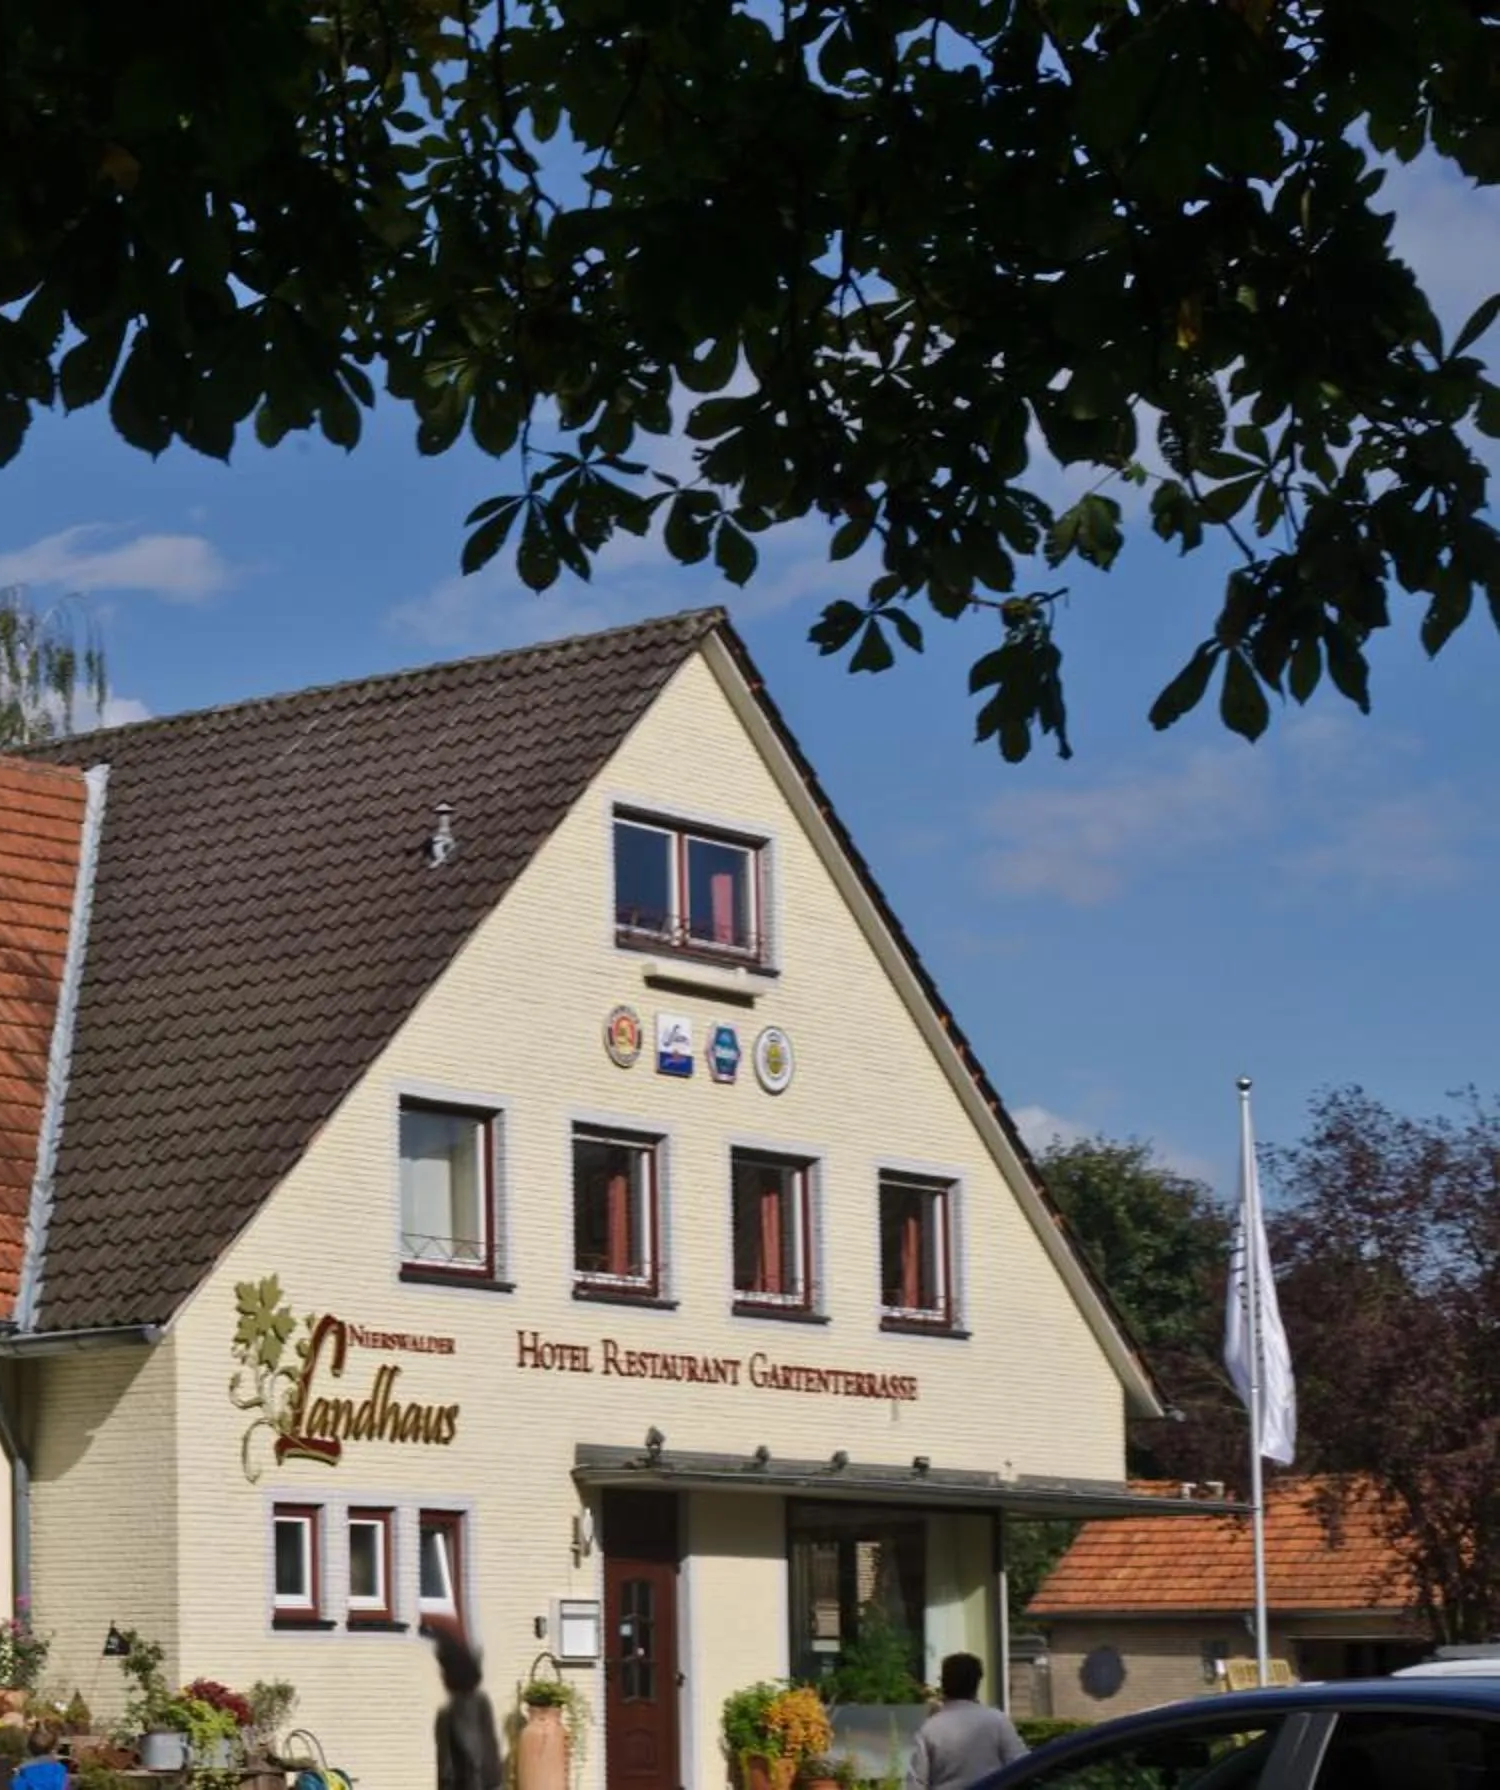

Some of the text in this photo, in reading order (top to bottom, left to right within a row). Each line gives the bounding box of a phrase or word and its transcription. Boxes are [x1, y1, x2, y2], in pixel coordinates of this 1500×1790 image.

[348, 1325, 456, 1355] NIERSWALDER
[516, 1330, 917, 1401] HOTEL RESTAURANT GARTENTERRASSE
[275, 1315, 460, 1466] Landhaus
